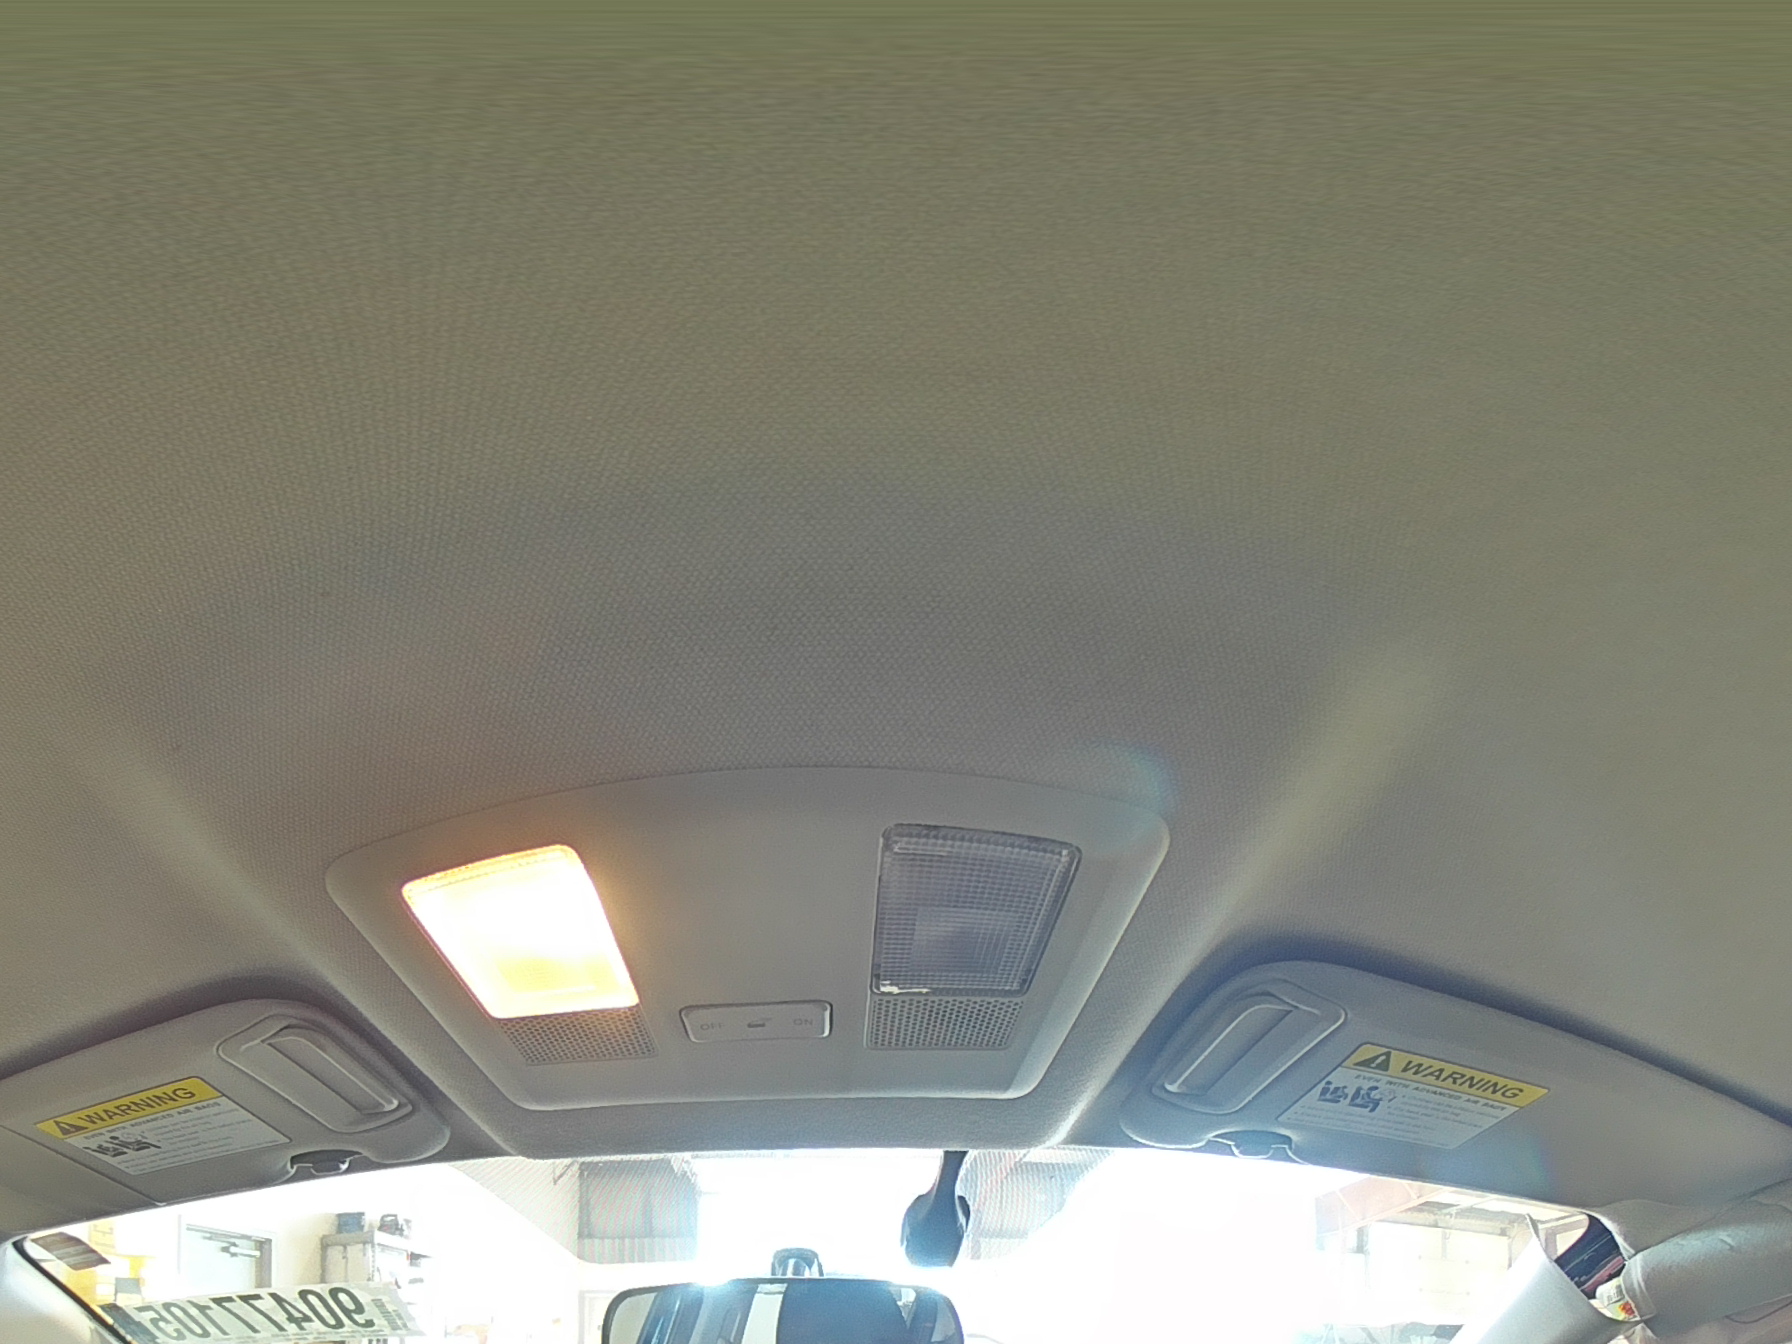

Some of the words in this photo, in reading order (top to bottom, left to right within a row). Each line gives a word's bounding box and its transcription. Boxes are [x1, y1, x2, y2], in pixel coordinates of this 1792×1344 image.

[700, 1023, 725, 1031] OFF
[793, 1018, 813, 1026] ON
[1401, 1060, 1525, 1100] WARNING
[78, 1087, 197, 1125] WARNING
